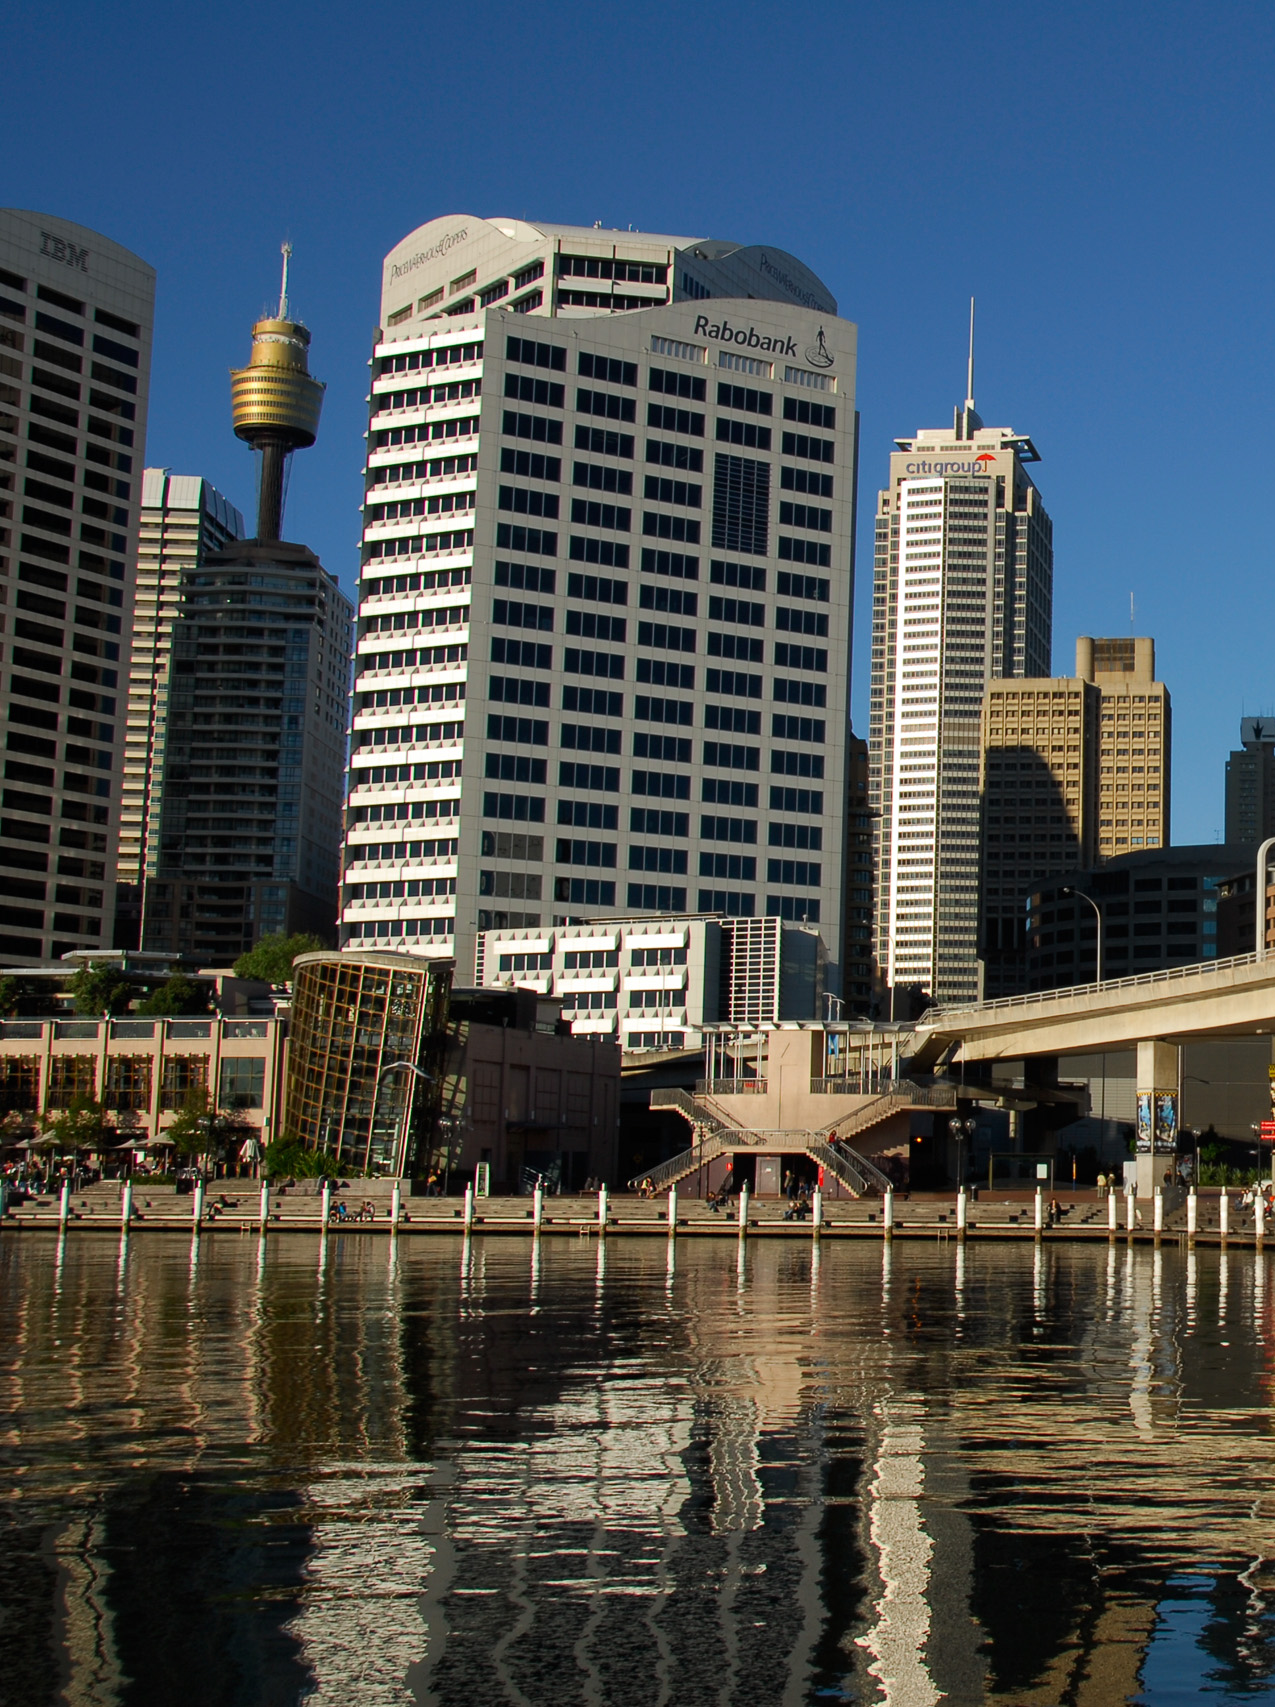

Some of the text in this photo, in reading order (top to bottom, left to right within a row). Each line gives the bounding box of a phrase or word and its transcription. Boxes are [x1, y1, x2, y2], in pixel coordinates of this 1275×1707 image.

[40, 231, 89, 273] IBM
[694, 315, 798, 357] Rabobank
[906, 460, 982, 476] citigroup
